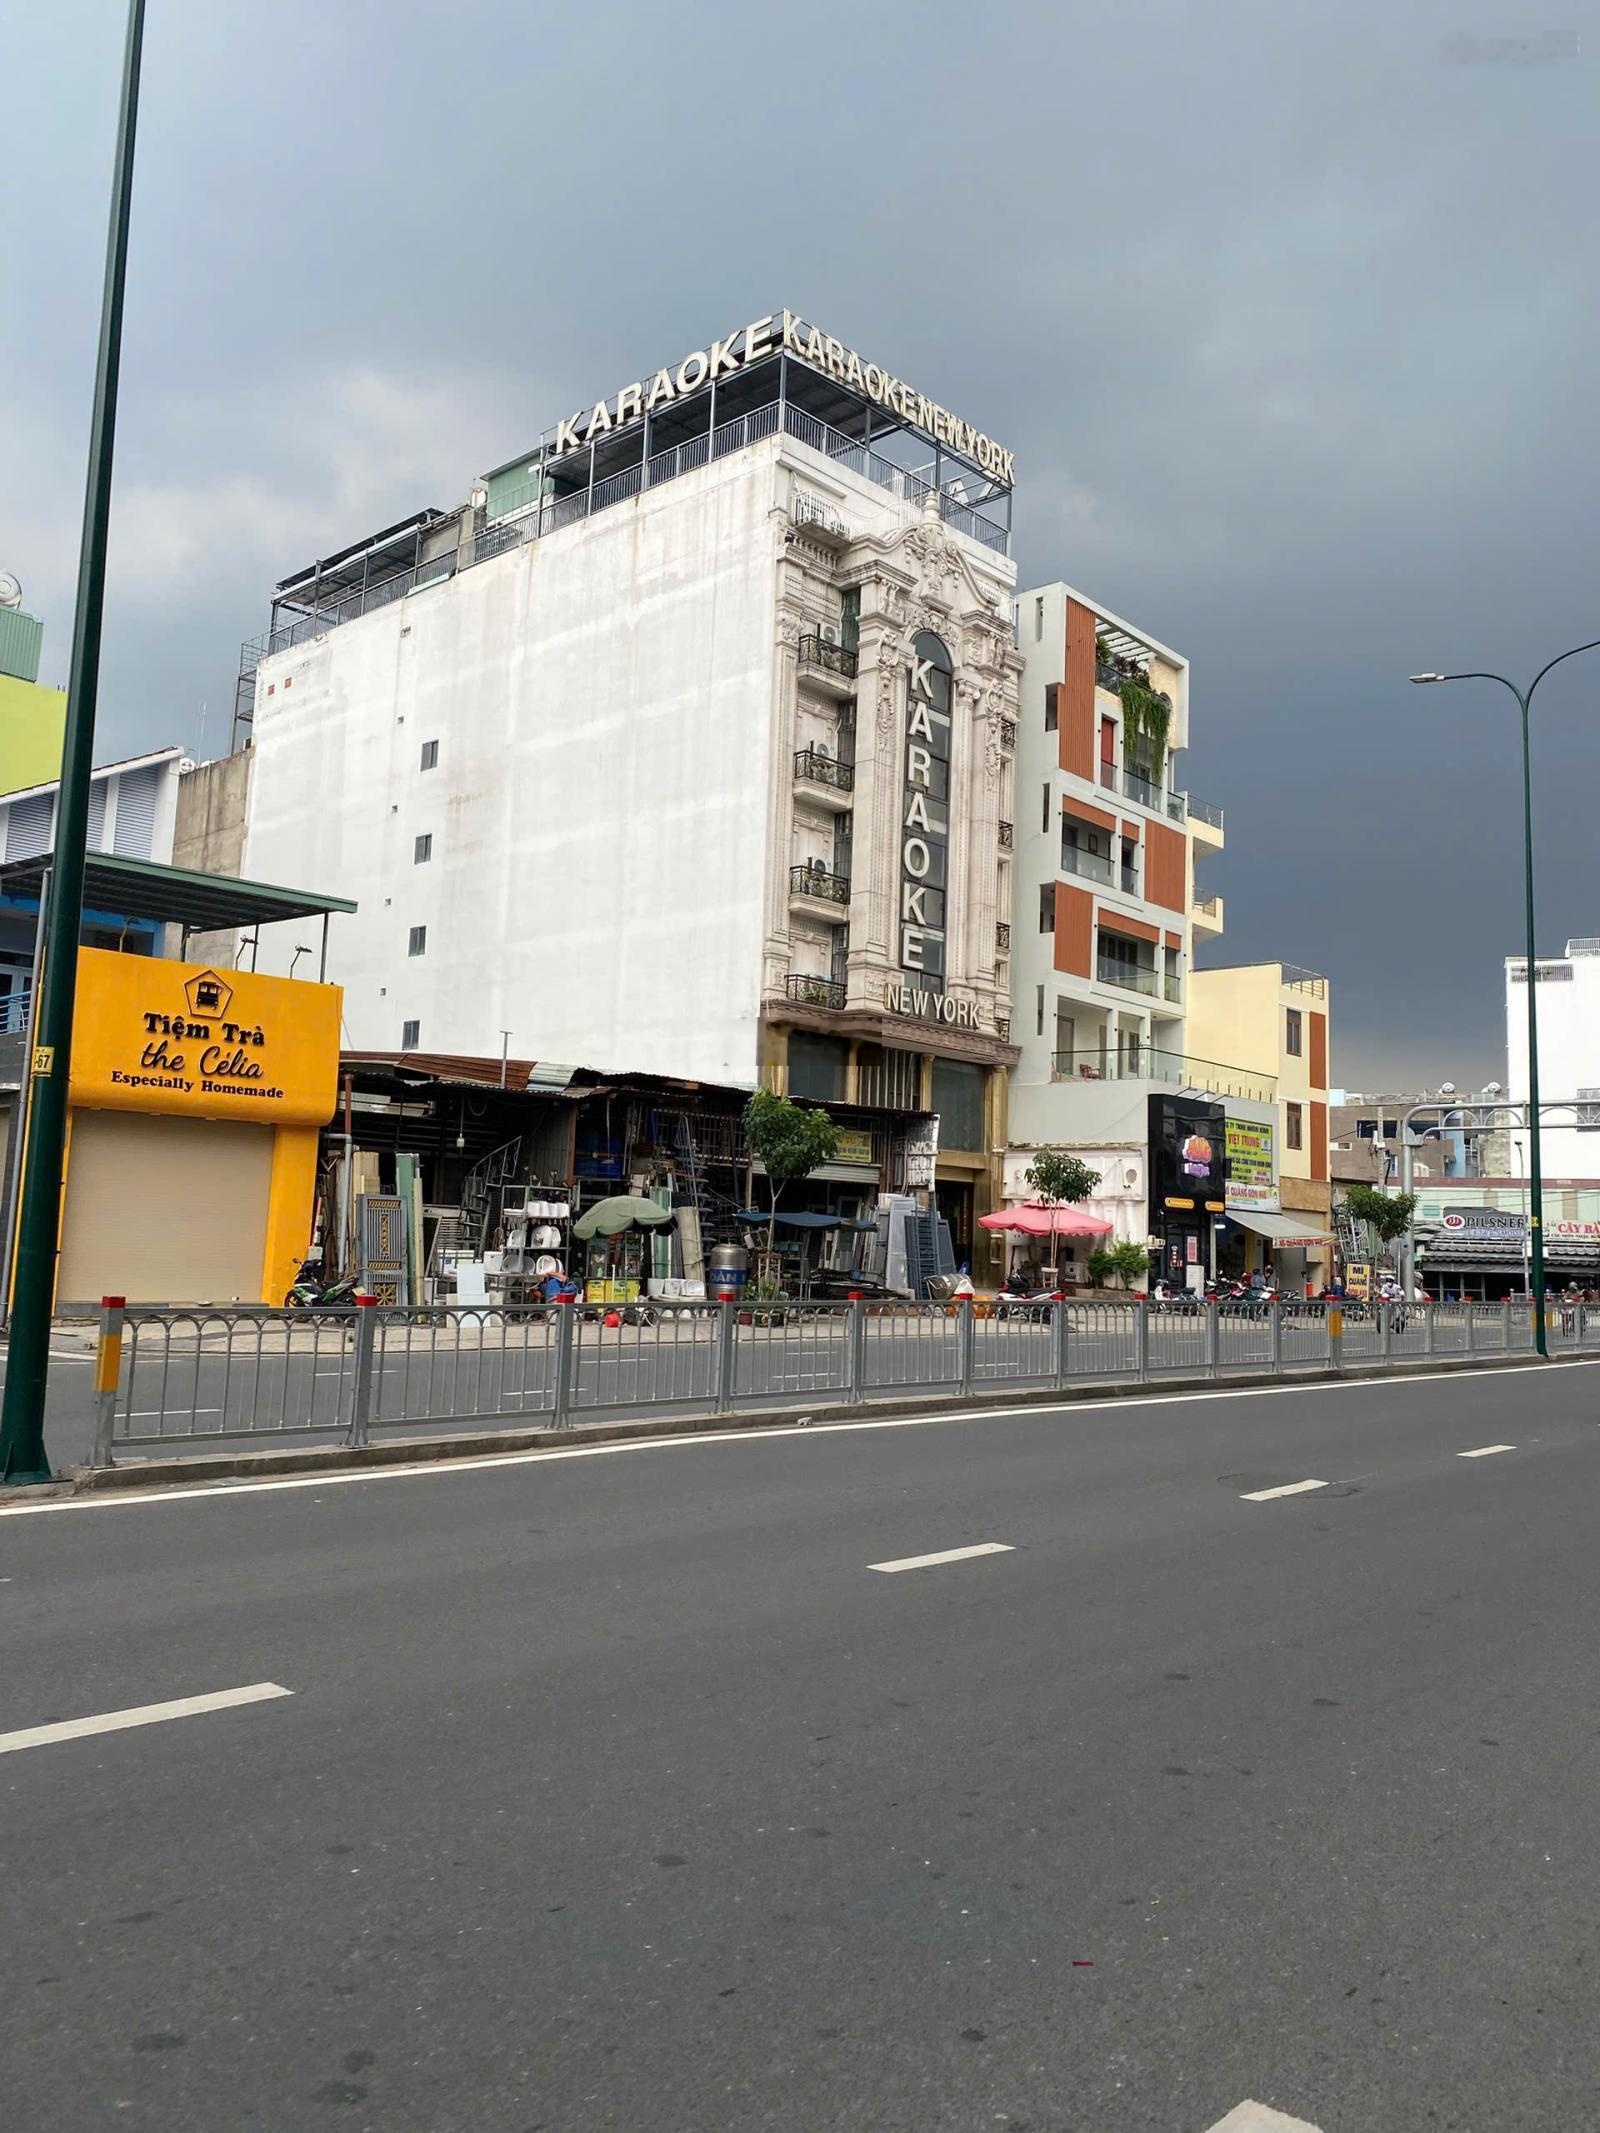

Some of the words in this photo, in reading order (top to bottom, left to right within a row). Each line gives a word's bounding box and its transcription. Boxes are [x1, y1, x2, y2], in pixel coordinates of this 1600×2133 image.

[556, 315, 773, 454] KARAOKE
[783, 308, 922, 424] KARAOKE
[918, 394, 968, 450] NEW
[964, 428, 1016, 487] YORK
[903, 657, 936, 970] KARAOKE
[885, 983, 931, 1016] NEW
[933, 992, 980, 1029] YORK
[144, 1012, 209, 1041] Tiệm
[222, 1022, 265, 1046] Trà
[140, 1040, 186, 1071] the
[200, 1046, 264, 1079] Célia
[111, 1071, 194, 1092] Especially
[201, 1080, 284, 1098] Homemade
[1557, 1222, 1581, 1233] CÂY
